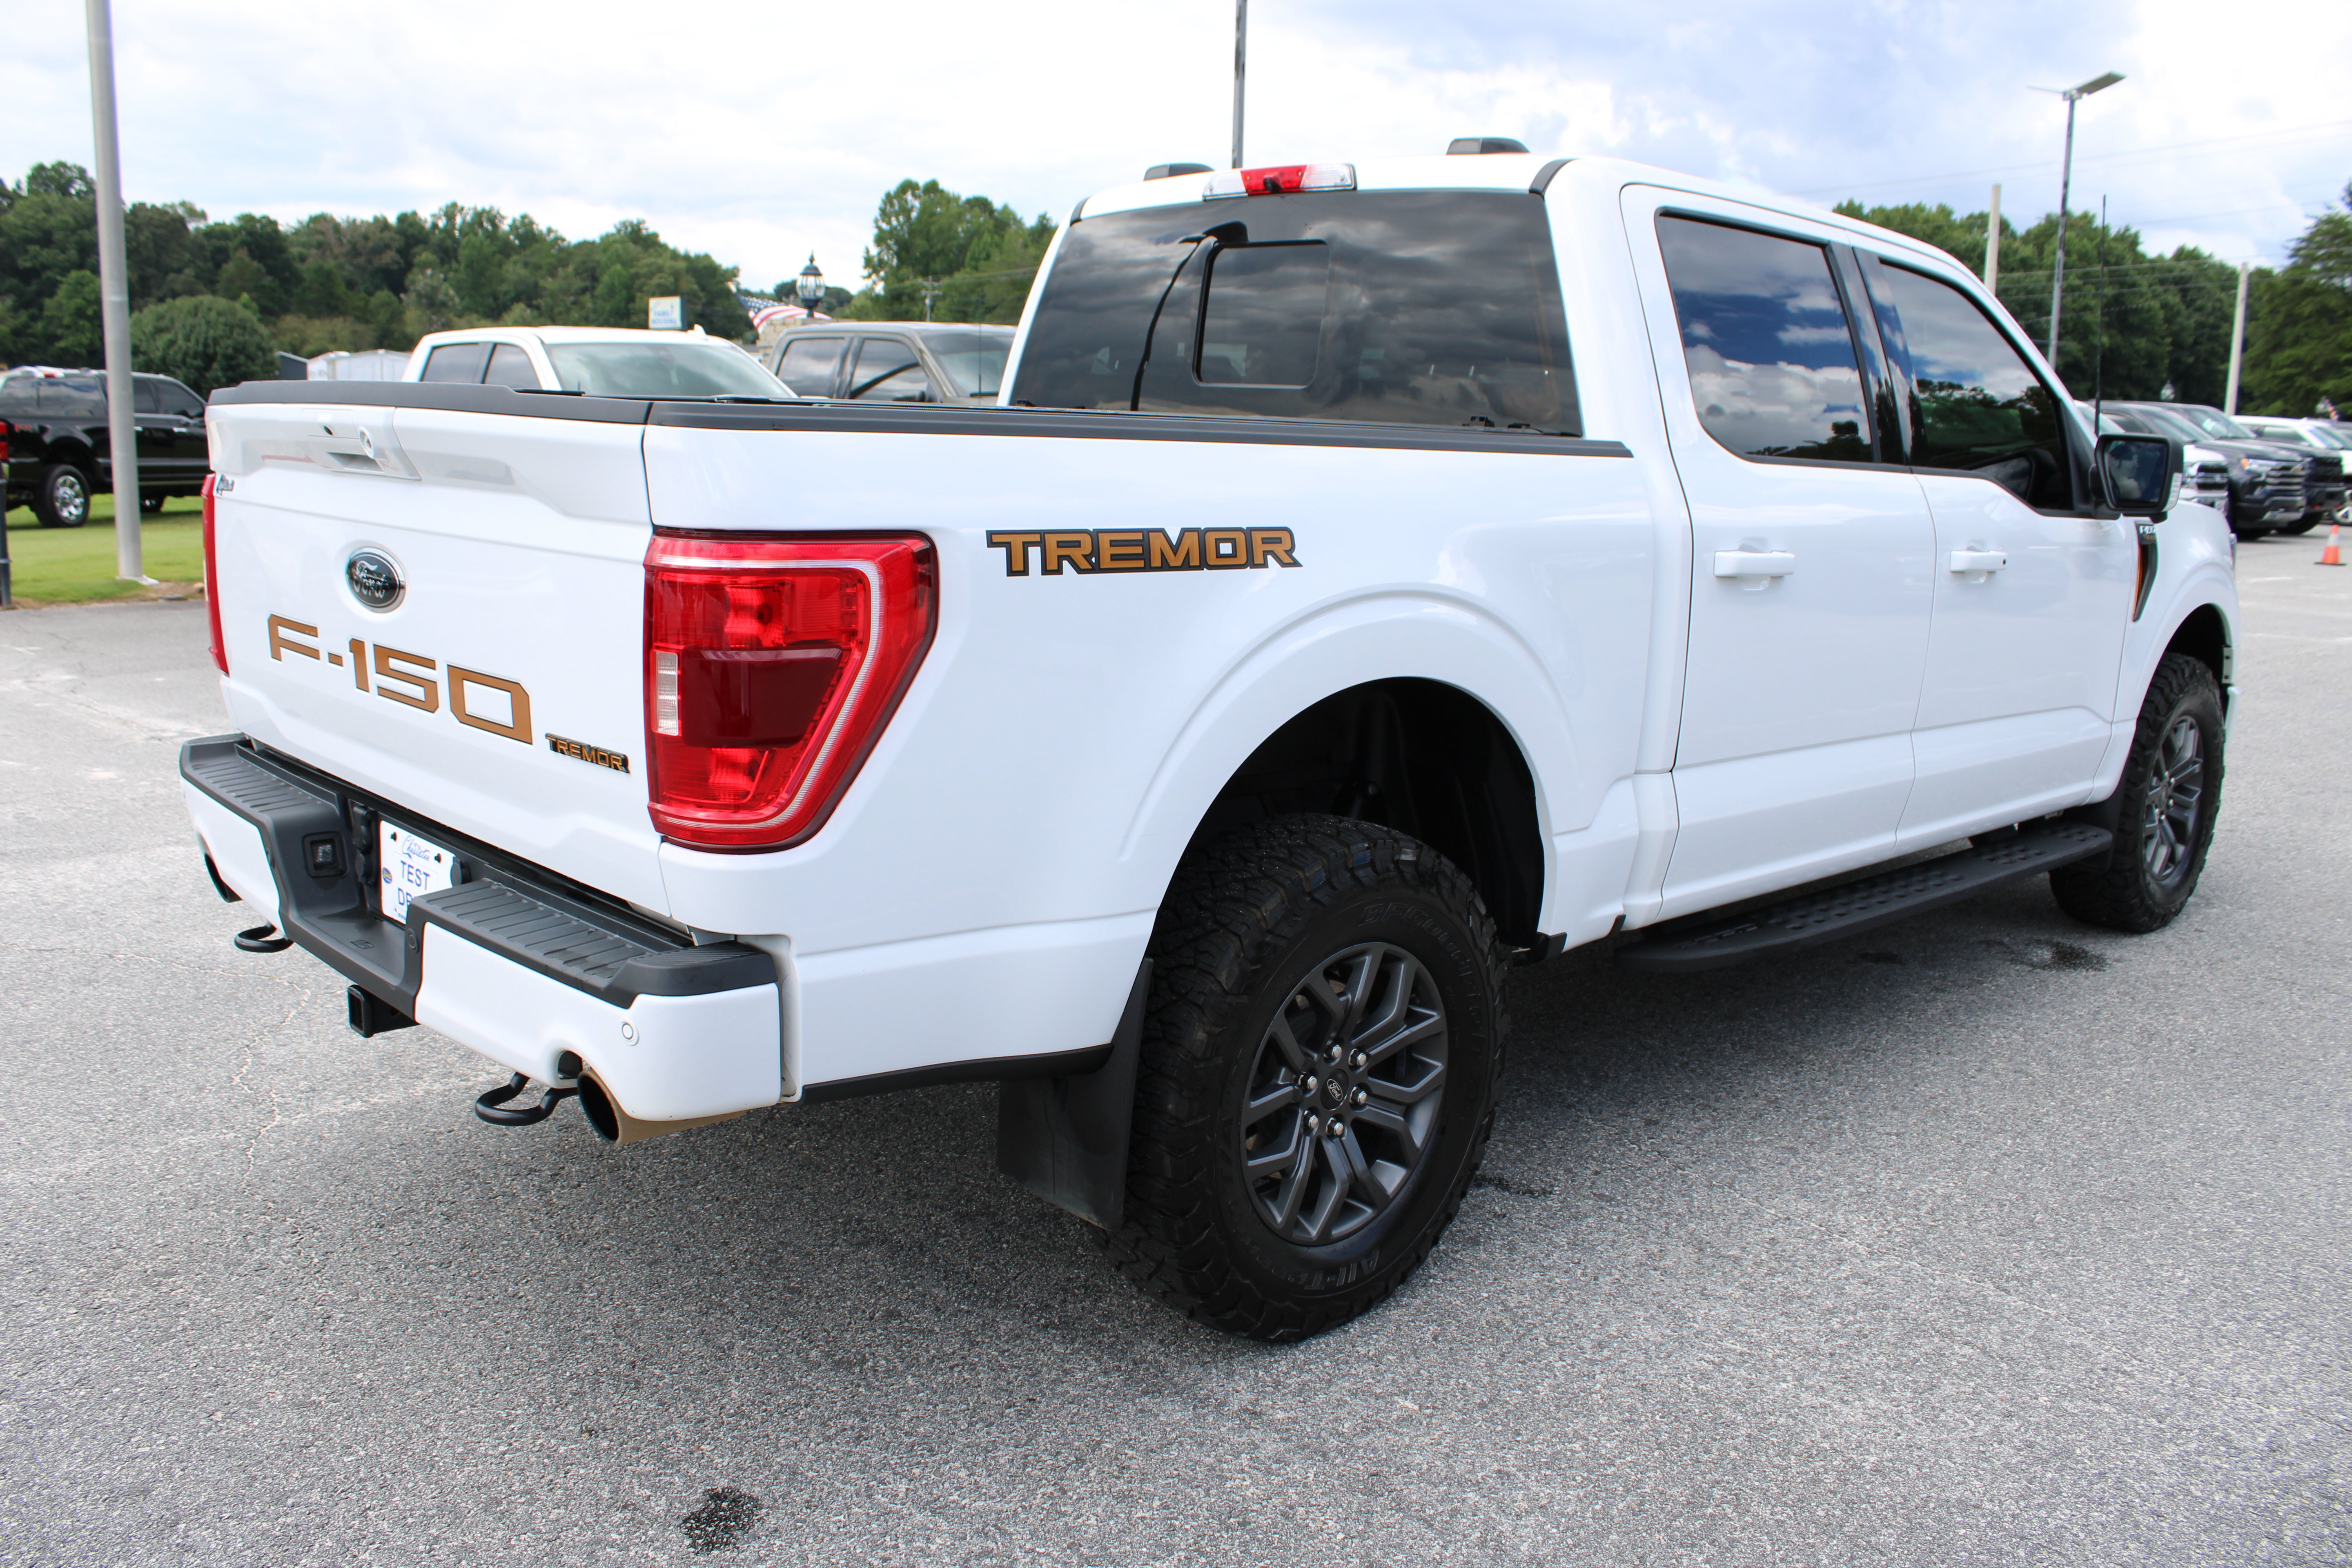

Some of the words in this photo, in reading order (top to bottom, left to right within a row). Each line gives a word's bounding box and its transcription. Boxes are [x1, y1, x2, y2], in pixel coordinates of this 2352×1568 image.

[986, 526, 1303, 577] TREMOR
[352, 560, 386, 599] Ford
[267, 614, 533, 745] F-150
[545, 733, 630, 773] TREMOR
[401, 860, 430, 891] TEST
[398, 887, 414, 906] DR
[1329, 1082, 1341, 1098] Ford
